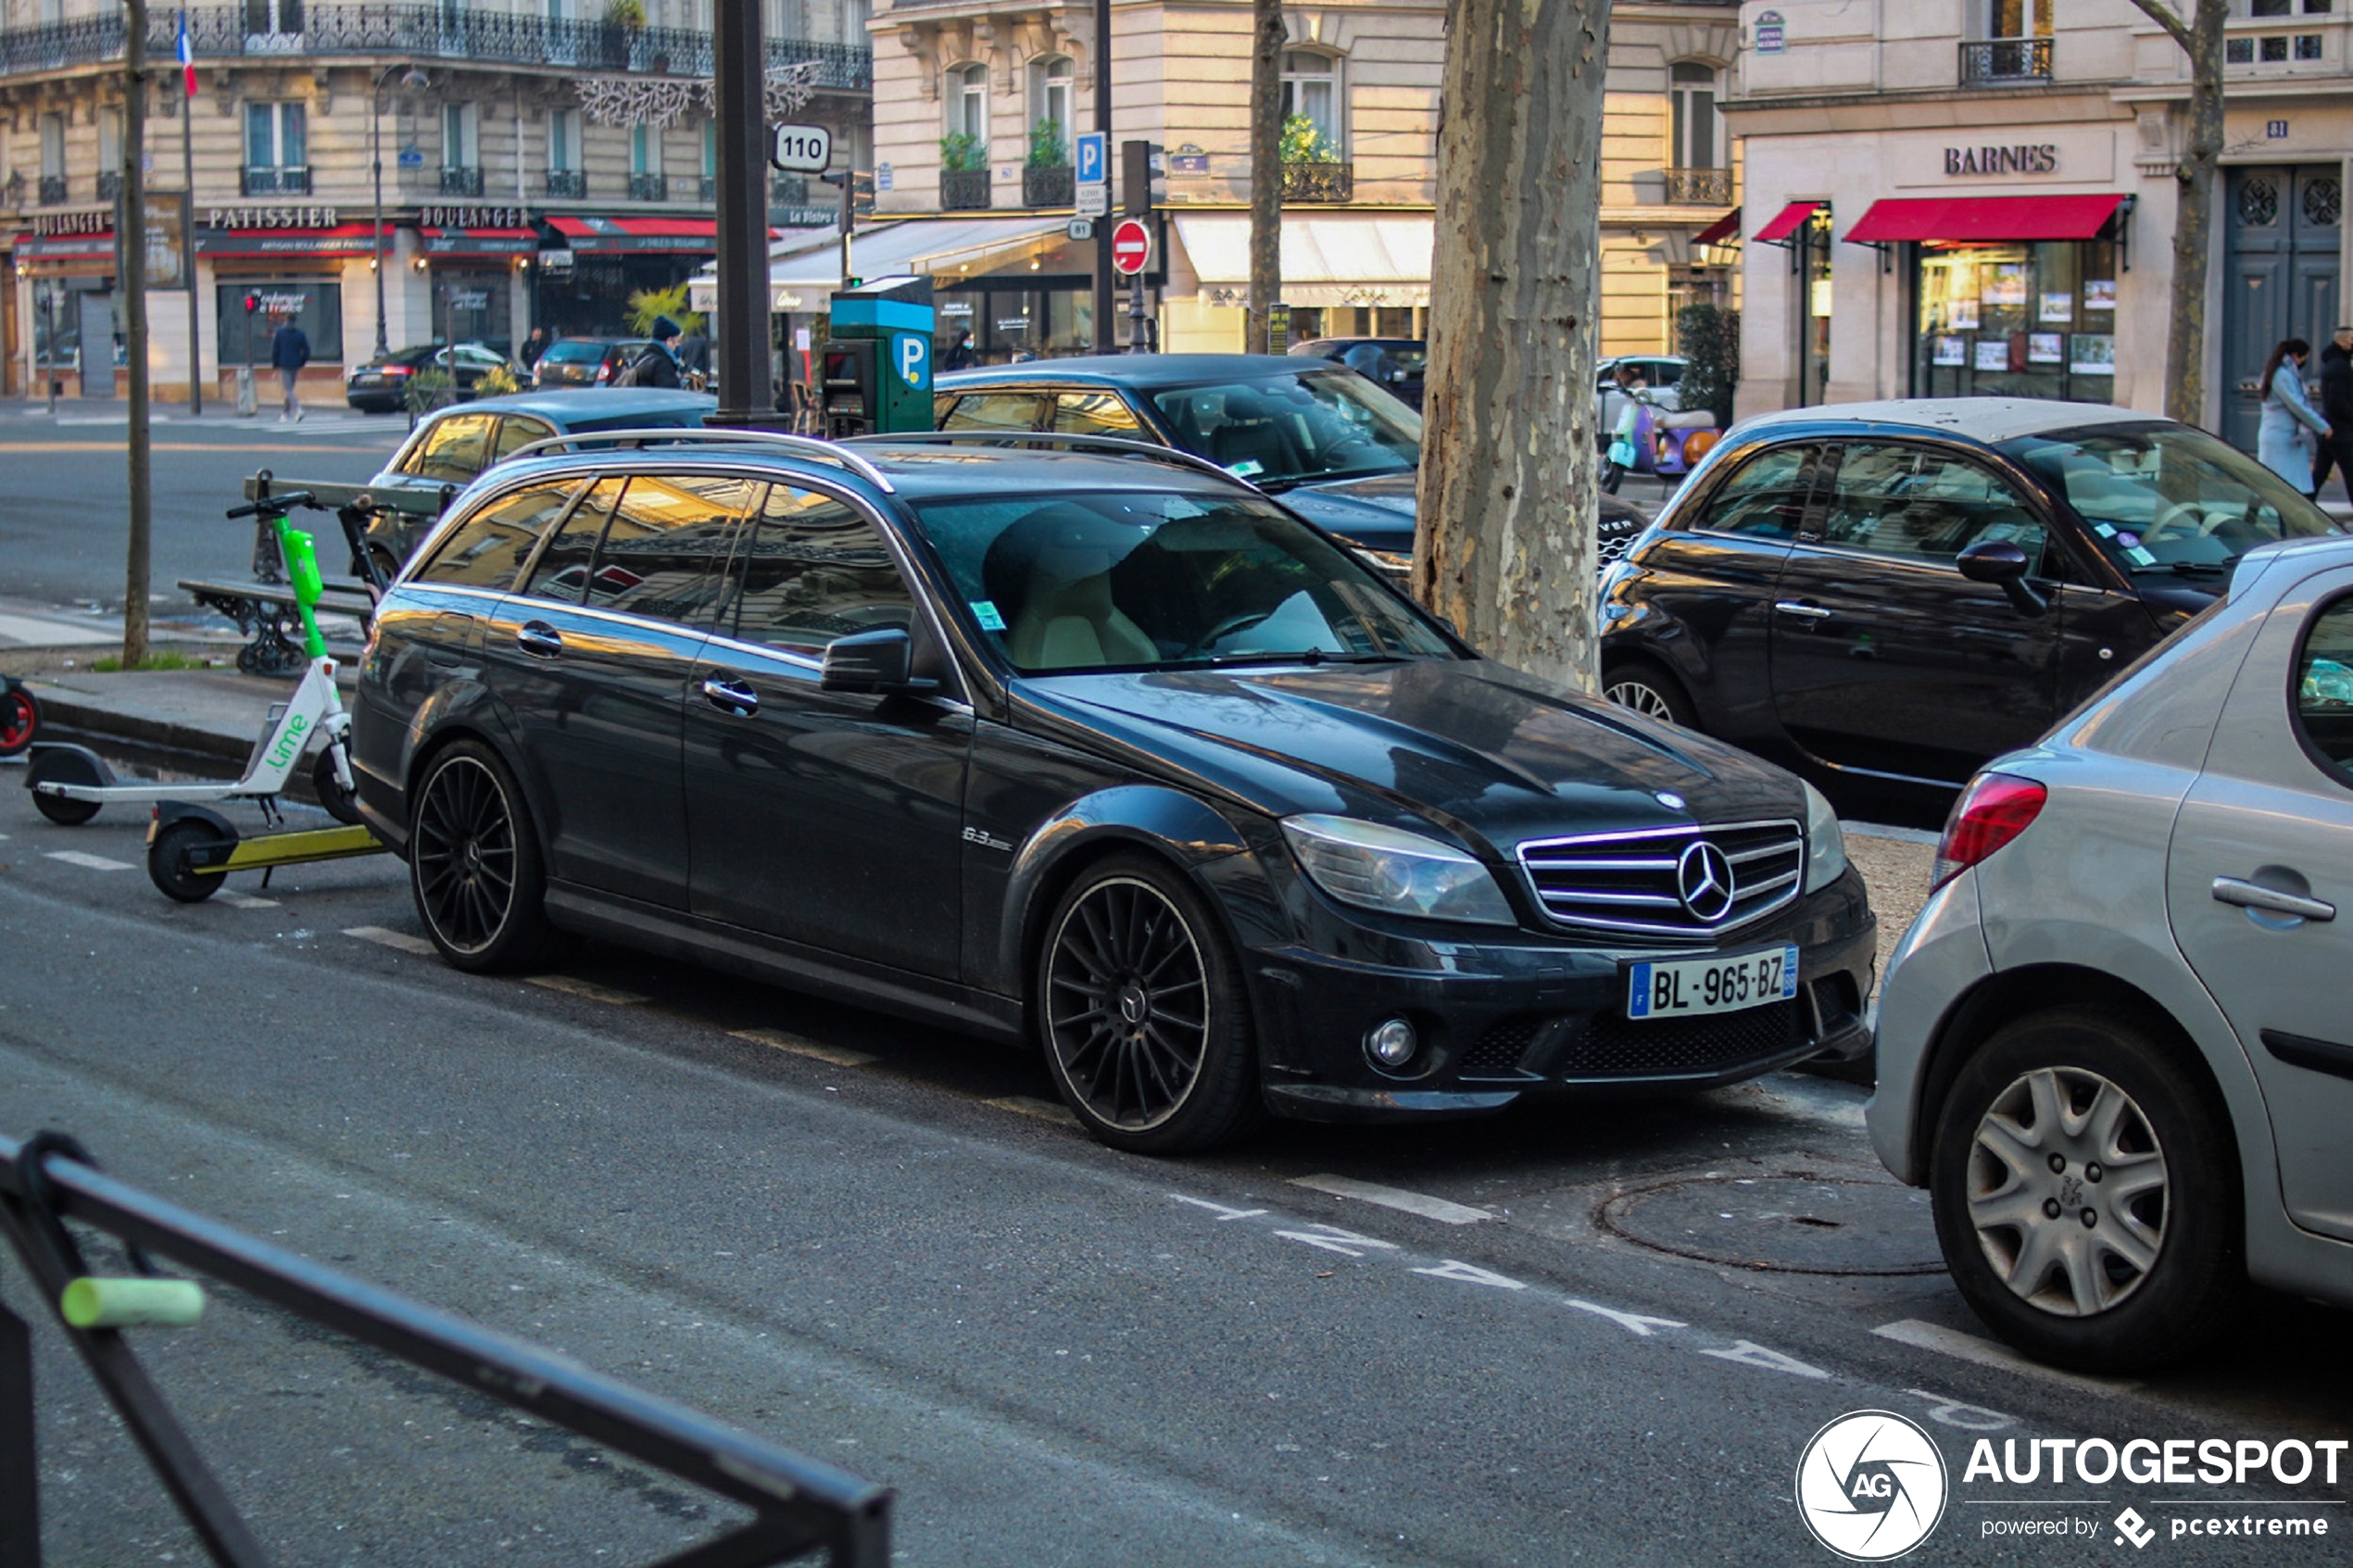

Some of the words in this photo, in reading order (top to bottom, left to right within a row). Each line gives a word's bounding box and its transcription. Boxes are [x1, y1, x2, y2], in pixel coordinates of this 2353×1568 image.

[784, 136, 823, 159] 110
[1083, 144, 1096, 176] P
[1944, 144, 2057, 175] BARNES
[34, 212, 105, 236] BOULANGER
[208, 207, 337, 229] PATISSIER
[421, 207, 529, 228] BOULANGER
[903, 338, 925, 380] P
[265, 713, 308, 769] Lime
[1654, 956, 1782, 1010] BL-965-BZ
